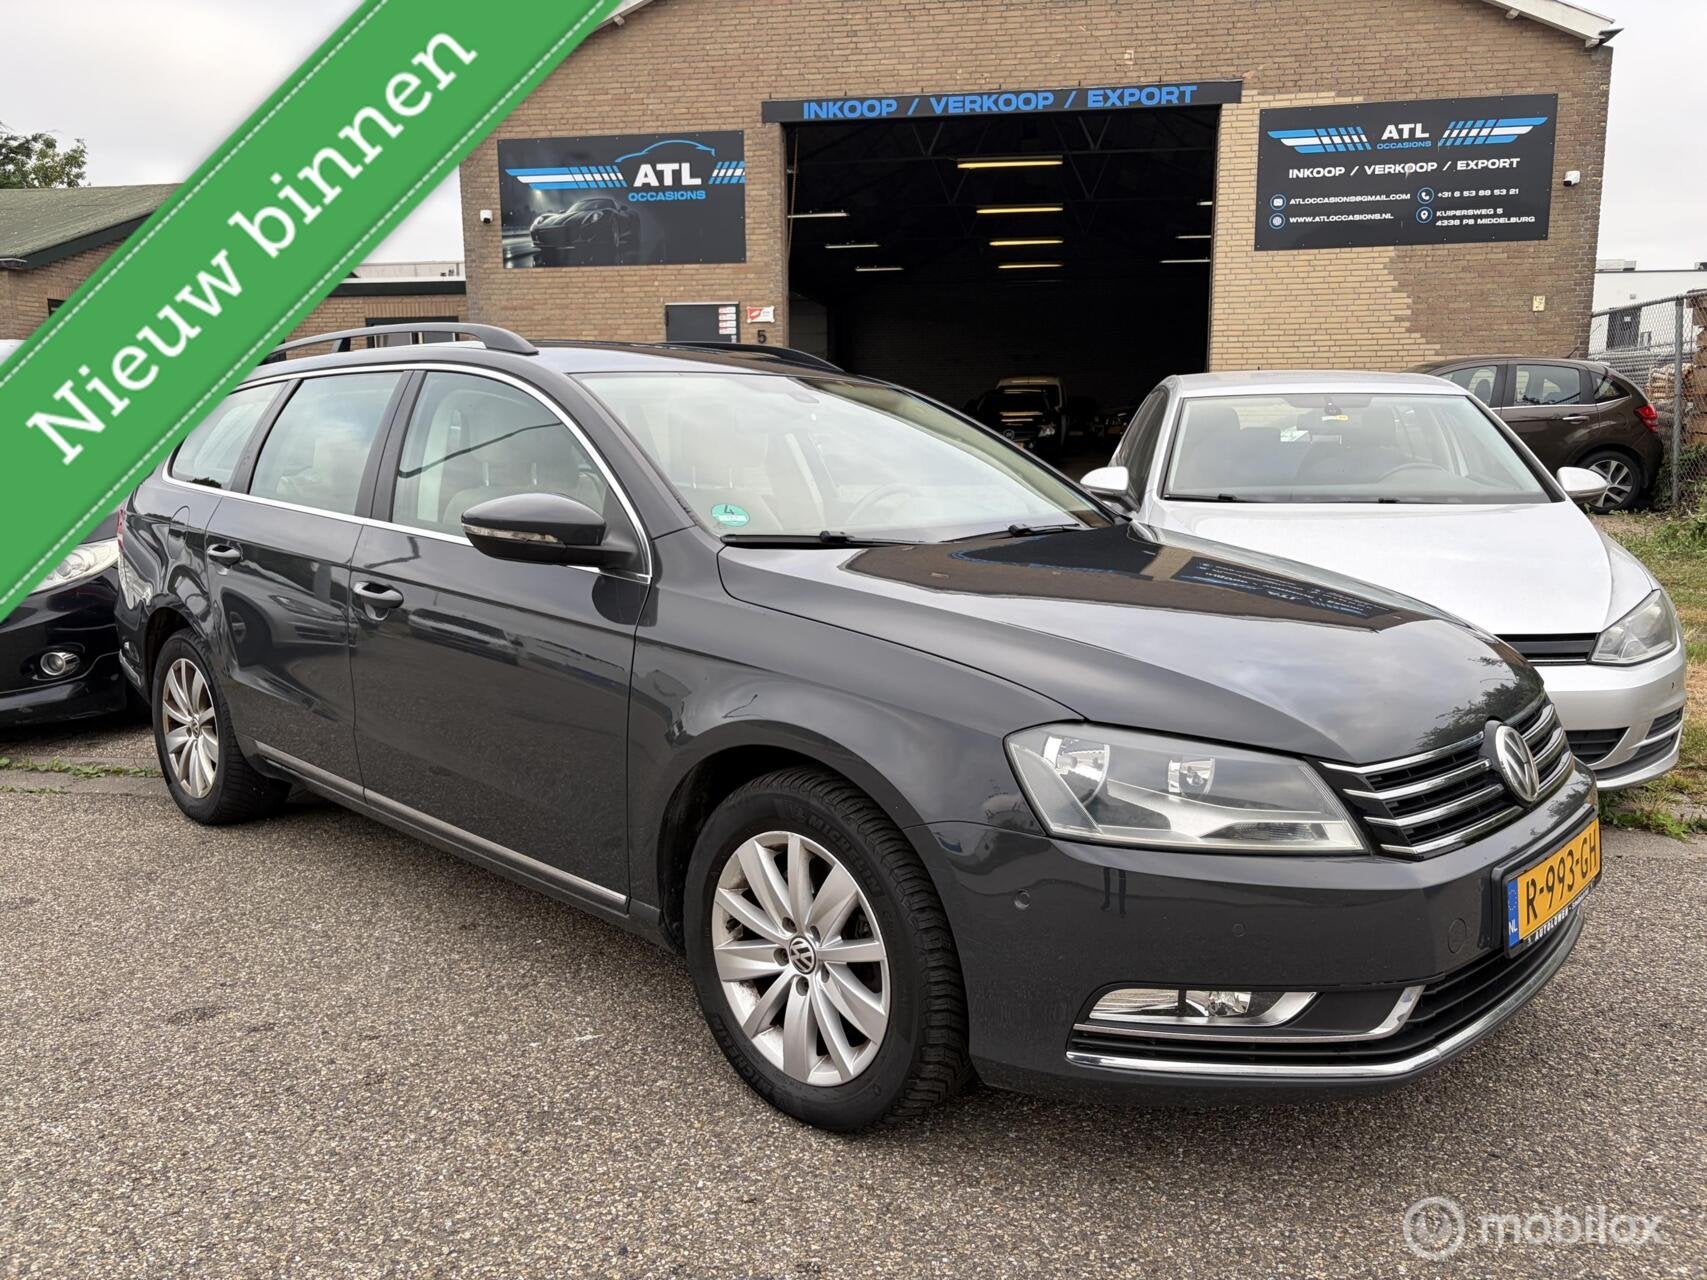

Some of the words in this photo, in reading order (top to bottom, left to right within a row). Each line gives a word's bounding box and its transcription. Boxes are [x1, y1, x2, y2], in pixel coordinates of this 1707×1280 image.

[802, 99, 898, 120] INKOOP
[928, 91, 1055, 115] VERKOOP
[1087, 85, 1198, 109] EXPORT
[1380, 122, 1430, 141] ATL
[1376, 140, 1432, 151] OCCASIONS
[633, 162, 703, 187] ATL
[1288, 166, 1346, 179] INKOOP
[1364, 162, 1438, 175] VERKOOP
[1457, 158, 1521, 170] EXPORT
[628, 190, 706, 202] OCCASIONS
[1289, 213, 1394, 223] WWW.ATLOCCASIONS.NL
[1436, 208, 1494, 217] KUIPERSWEG
[1477, 216, 1536, 225] MIDDELBURG
[757, 329, 767, 344] 5
[1525, 828, 1597, 926] R-993-GH
[1508, 918, 1518, 936] NL
